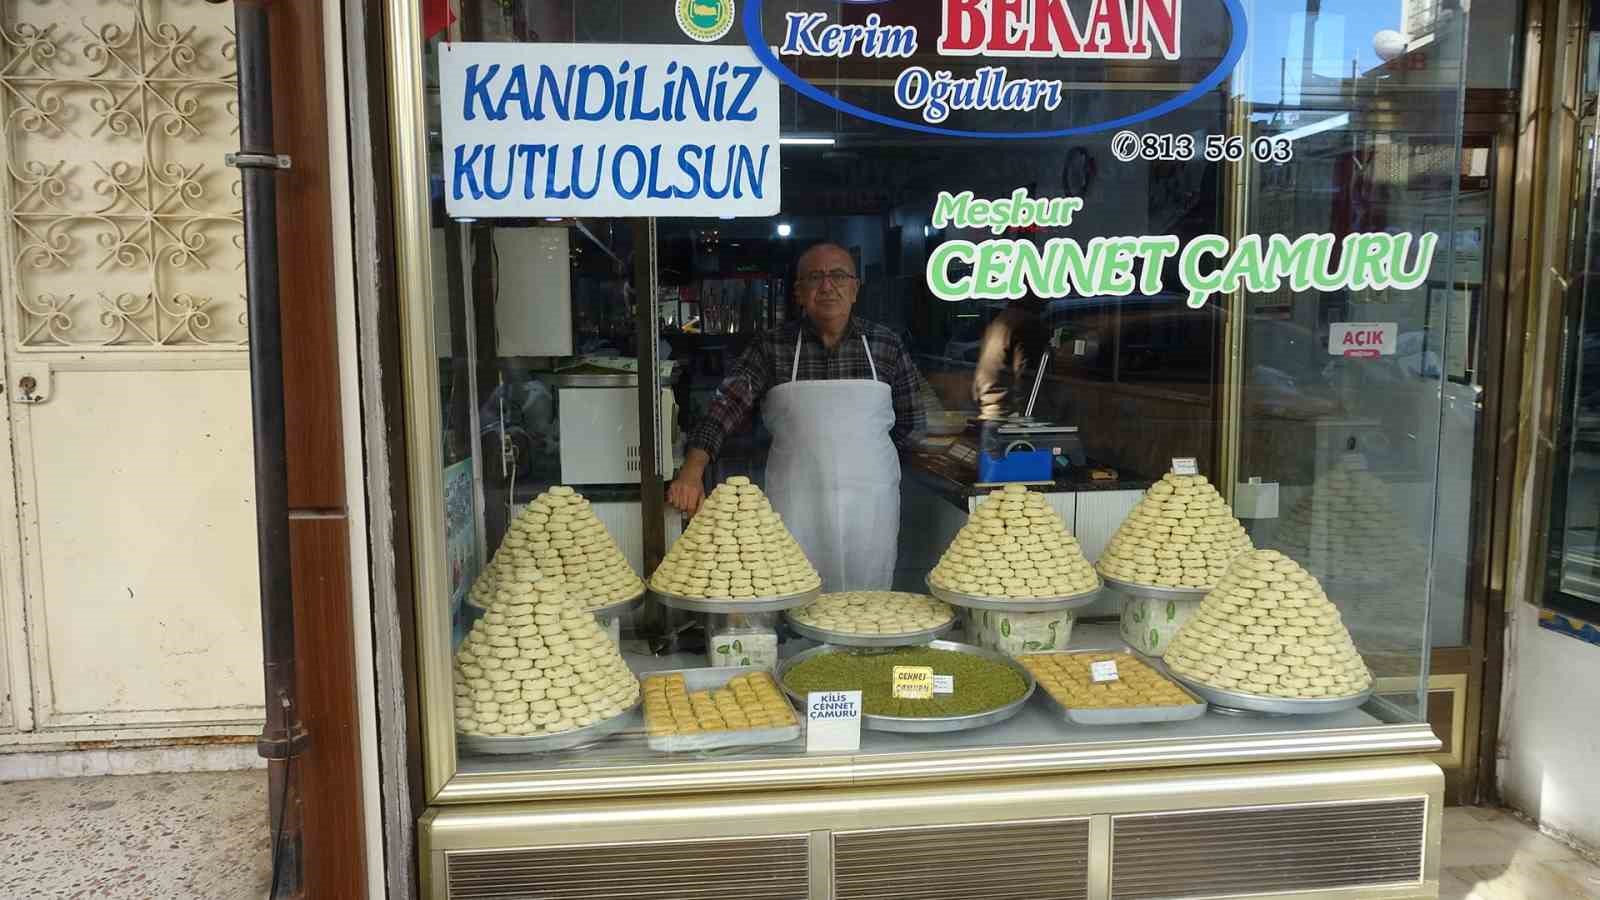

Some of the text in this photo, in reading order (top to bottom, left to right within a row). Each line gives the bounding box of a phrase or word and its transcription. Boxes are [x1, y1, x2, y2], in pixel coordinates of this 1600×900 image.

[782, 13, 917, 57] Kerim
[938, 0, 1181, 58] BEKAN
[895, 67, 1062, 122] Oğulları
[1141, 133, 1293, 162] 813 56 03
[453, 143, 769, 200] KUTLU OLSUN
[926, 232, 1438, 309] CENNET ÇAMURU
[1342, 329, 1384, 346] AÇIK
[809, 710, 857, 720] ÇAMURU
[812, 702, 855, 711] CENNET
